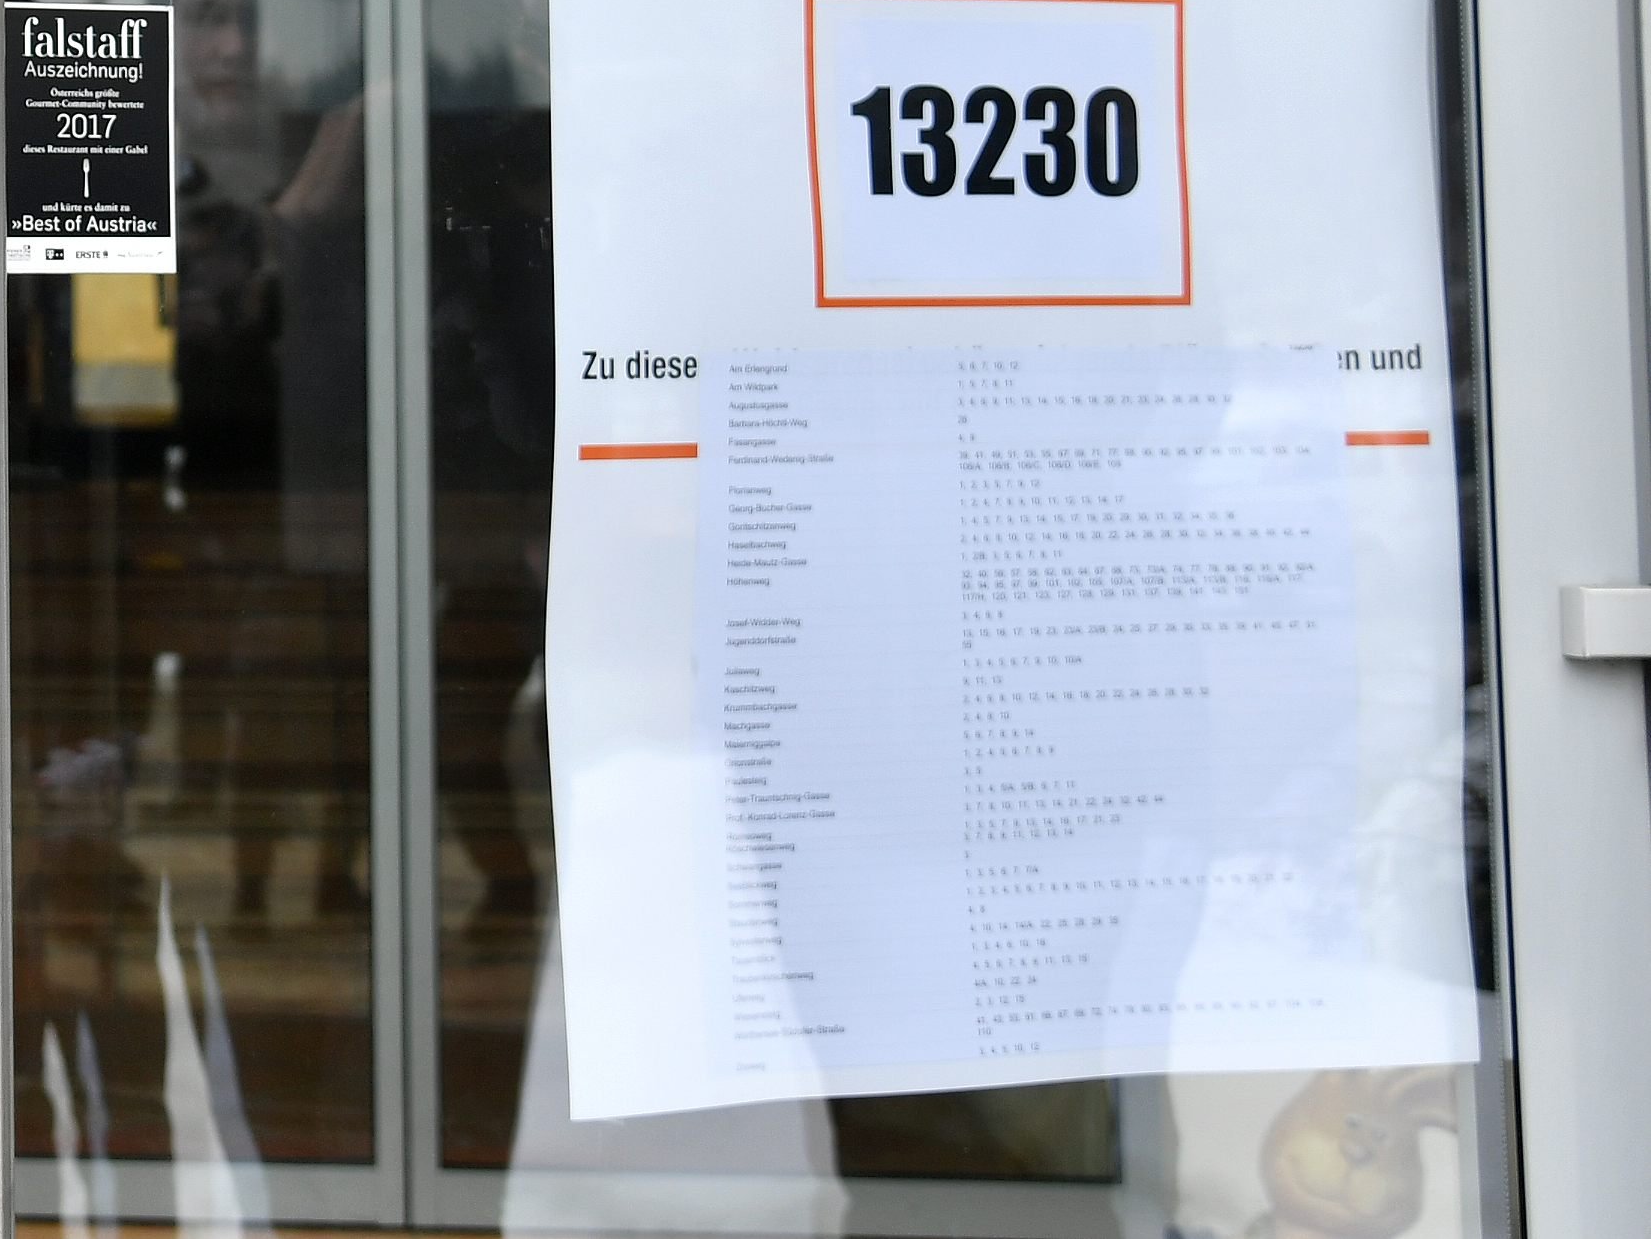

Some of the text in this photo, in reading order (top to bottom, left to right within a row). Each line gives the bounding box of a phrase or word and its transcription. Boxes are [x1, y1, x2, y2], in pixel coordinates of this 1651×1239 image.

[21, 16, 148, 59] falstaff
[24, 60, 143, 83] Auszeichnung!
[94, 88, 119, 99] größte
[25, 98, 145, 110] Gourmet-Community bewertete
[56, 112, 117, 139] 2017
[22, 144, 148, 155] dieses Restaurant mit einer Gabel
[850, 86, 1141, 199] 13230
[42, 202, 58, 212] und
[60, 202, 82, 212] kürte
[94, 202, 118, 212] damit
[12, 214, 158, 232] »Best of Austria«
[76, 251, 101, 259] ERSTE
[582, 350, 614, 380] Zu
[1371, 342, 1422, 370] und
